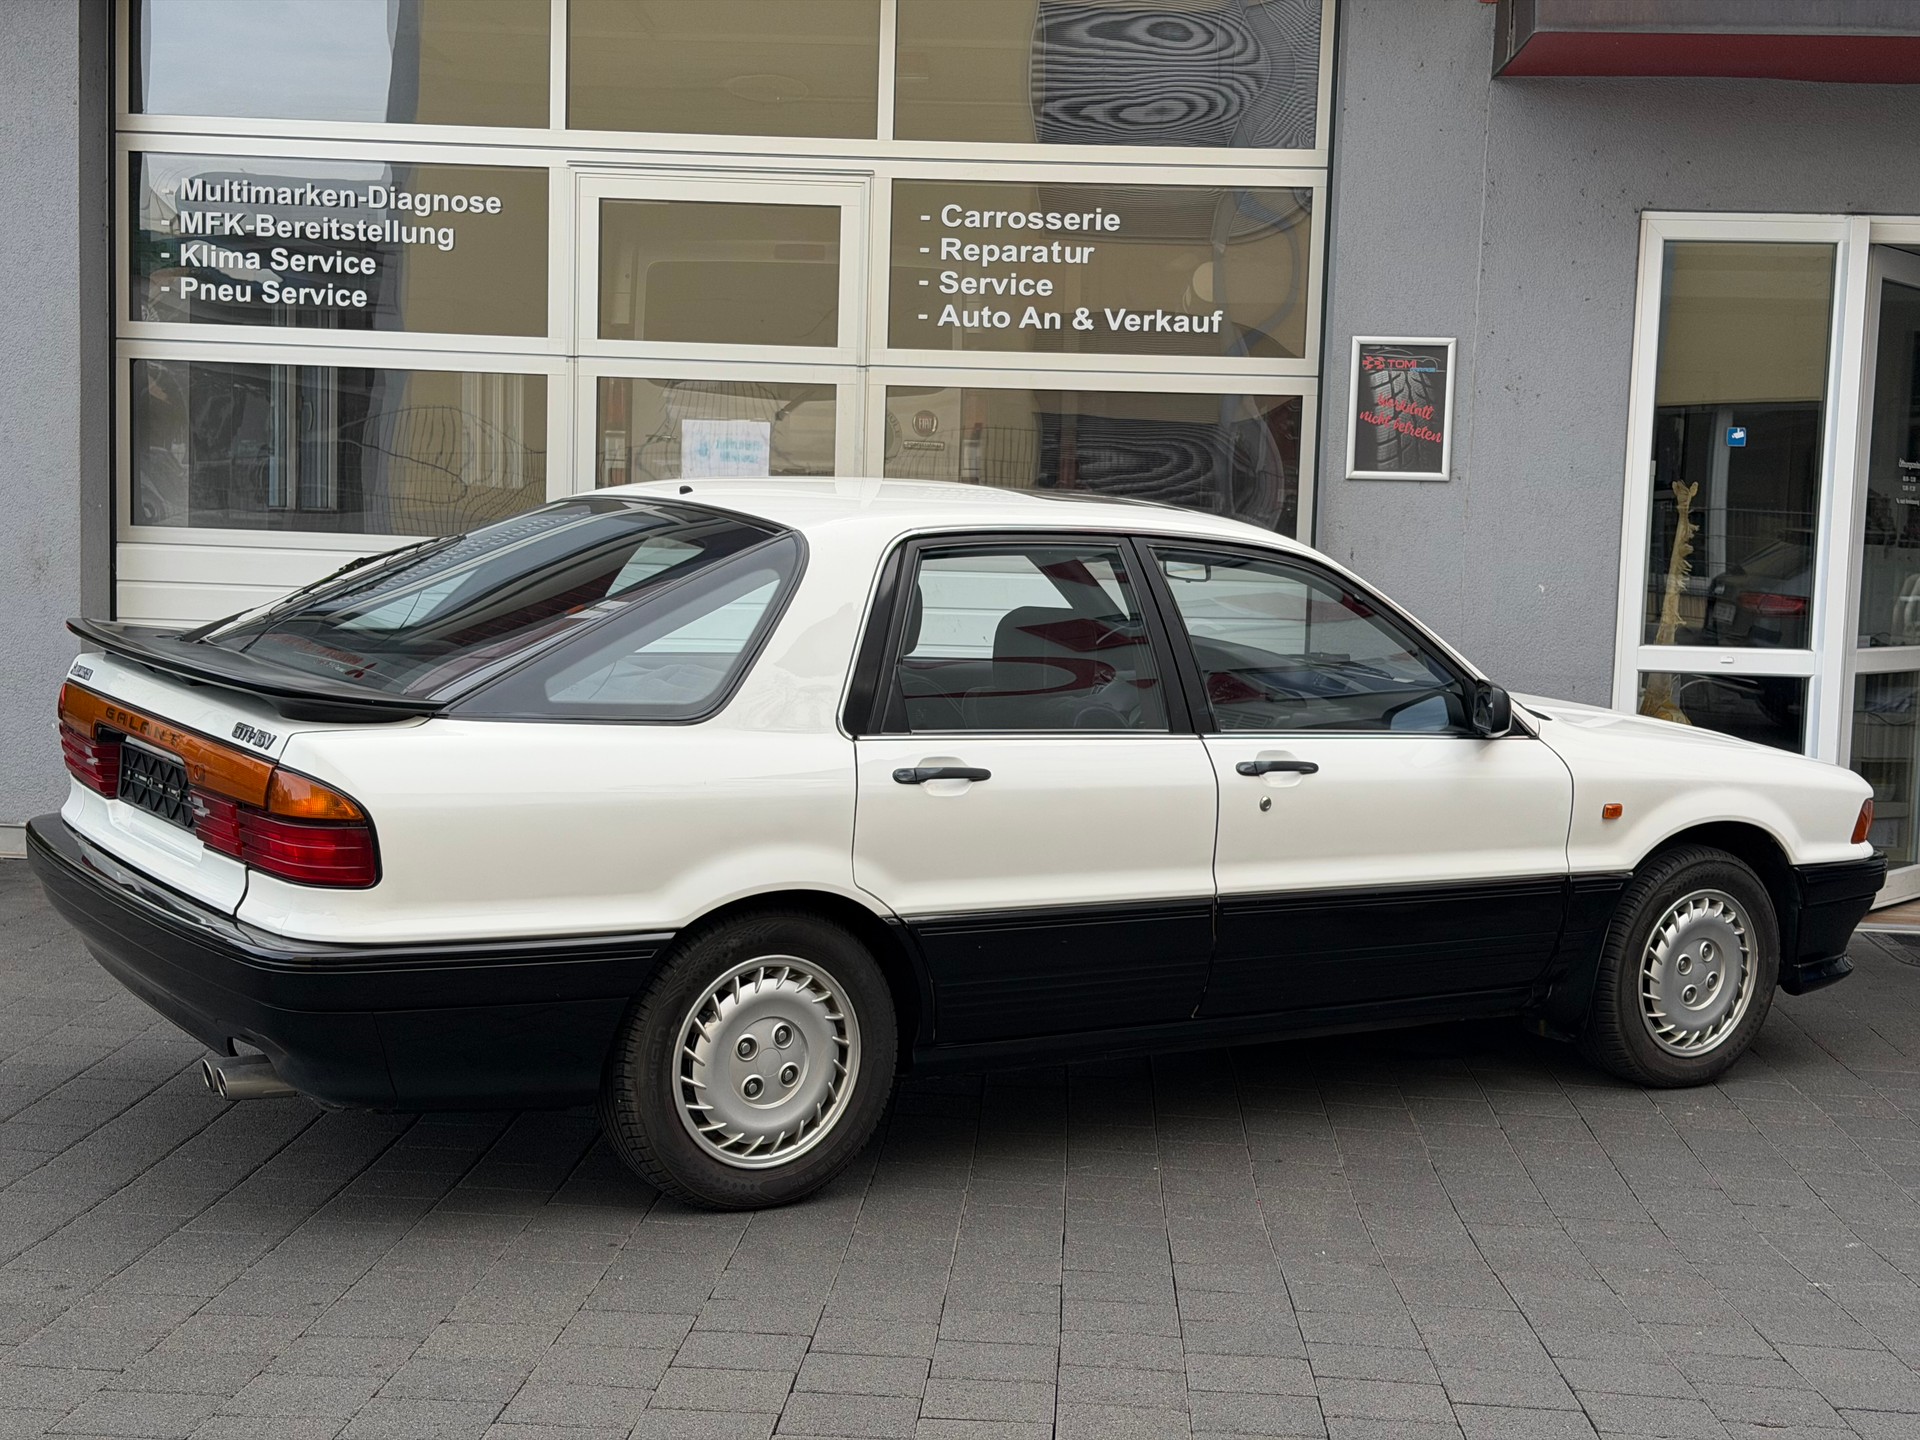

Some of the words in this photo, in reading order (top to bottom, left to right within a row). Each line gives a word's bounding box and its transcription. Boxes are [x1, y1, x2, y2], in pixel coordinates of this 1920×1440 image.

[180, 178, 502, 217] Multimarken-Diagnose
[180, 210, 455, 251] MFK-Bereitstellung
[940, 204, 1122, 231] Carrosserie
[180, 244, 261, 270] Klima
[270, 248, 377, 275] Service
[940, 237, 1096, 267] Reparatur
[180, 277, 252, 303] Pneu
[261, 281, 368, 307] Service
[938, 271, 1054, 297] Service
[937, 304, 1011, 329] Auto
[1018, 306, 1062, 330] An
[1072, 307, 1095, 331] &
[1104, 308, 1224, 334] Verkauf
[1388, 359, 1417, 369] TOMI
